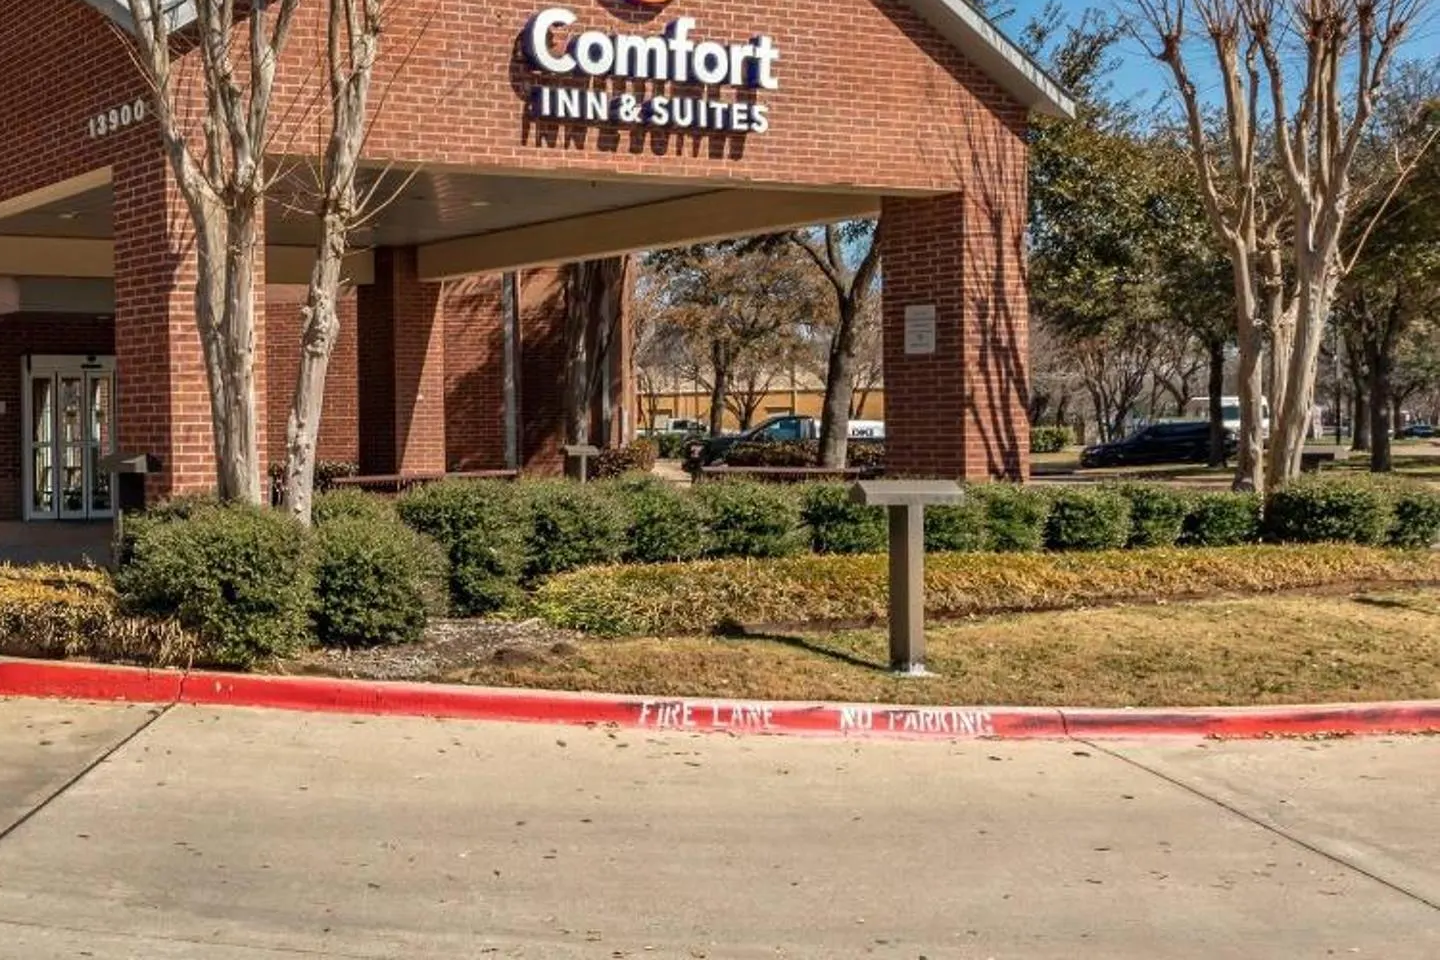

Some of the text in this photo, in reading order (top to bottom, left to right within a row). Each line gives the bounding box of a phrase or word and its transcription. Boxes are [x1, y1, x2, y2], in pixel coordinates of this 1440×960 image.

[529, 6, 781, 90] Comfort
[88, 97, 146, 139] 13900
[540, 87, 770, 134] INN & SUITES
[638, 701, 994, 735] FIRE LANE NO PARKING
